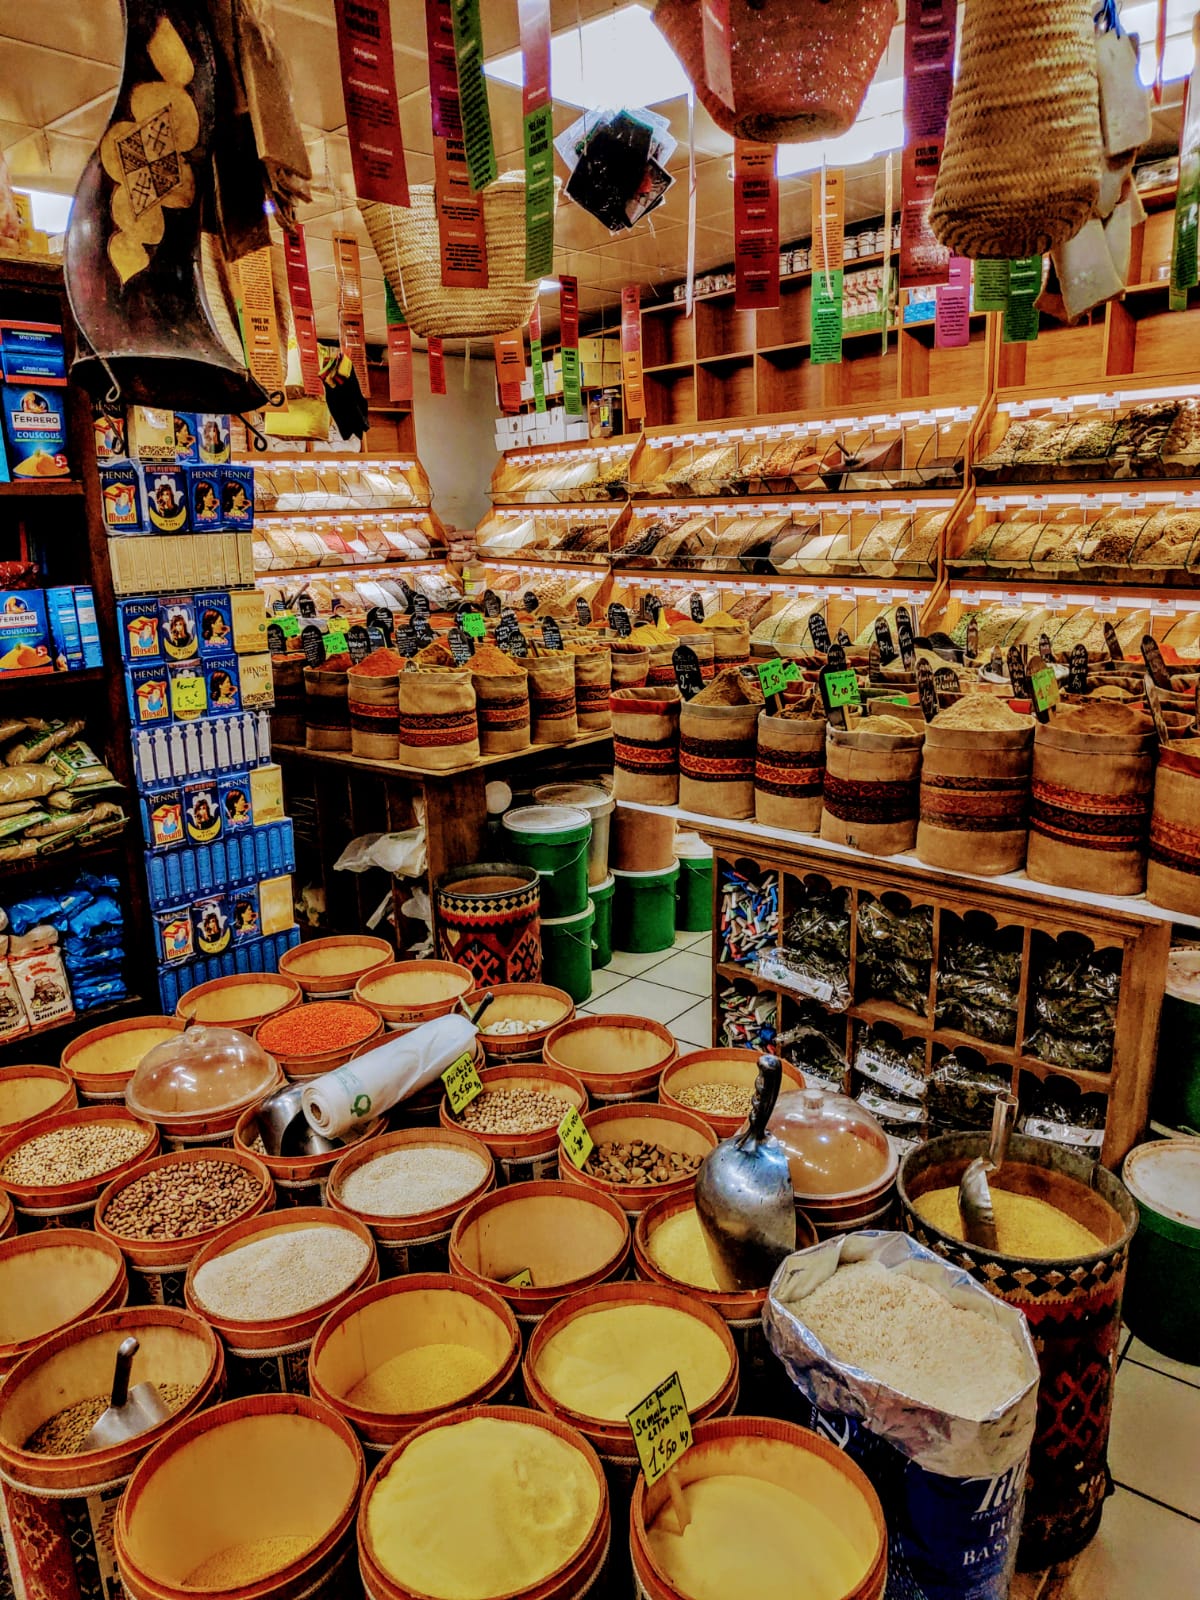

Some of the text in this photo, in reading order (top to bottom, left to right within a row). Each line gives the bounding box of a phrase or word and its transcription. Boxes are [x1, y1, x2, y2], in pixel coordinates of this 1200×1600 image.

[14, 414, 58, 424] FERRERO
[101, 470, 134, 480] HENNÉ
[192, 468, 219, 479] HENNÉ
[220, 470, 251, 480] HENNÉ
[198, 597, 228, 607] HENNÉ
[125, 603, 157, 614] HENNÉ
[206, 658, 236, 669] HENNÉ
[134, 667, 166, 679] HENNÉ
[221, 776, 249, 788] HENNÉ
[149, 790, 180, 805] HENNÉ
